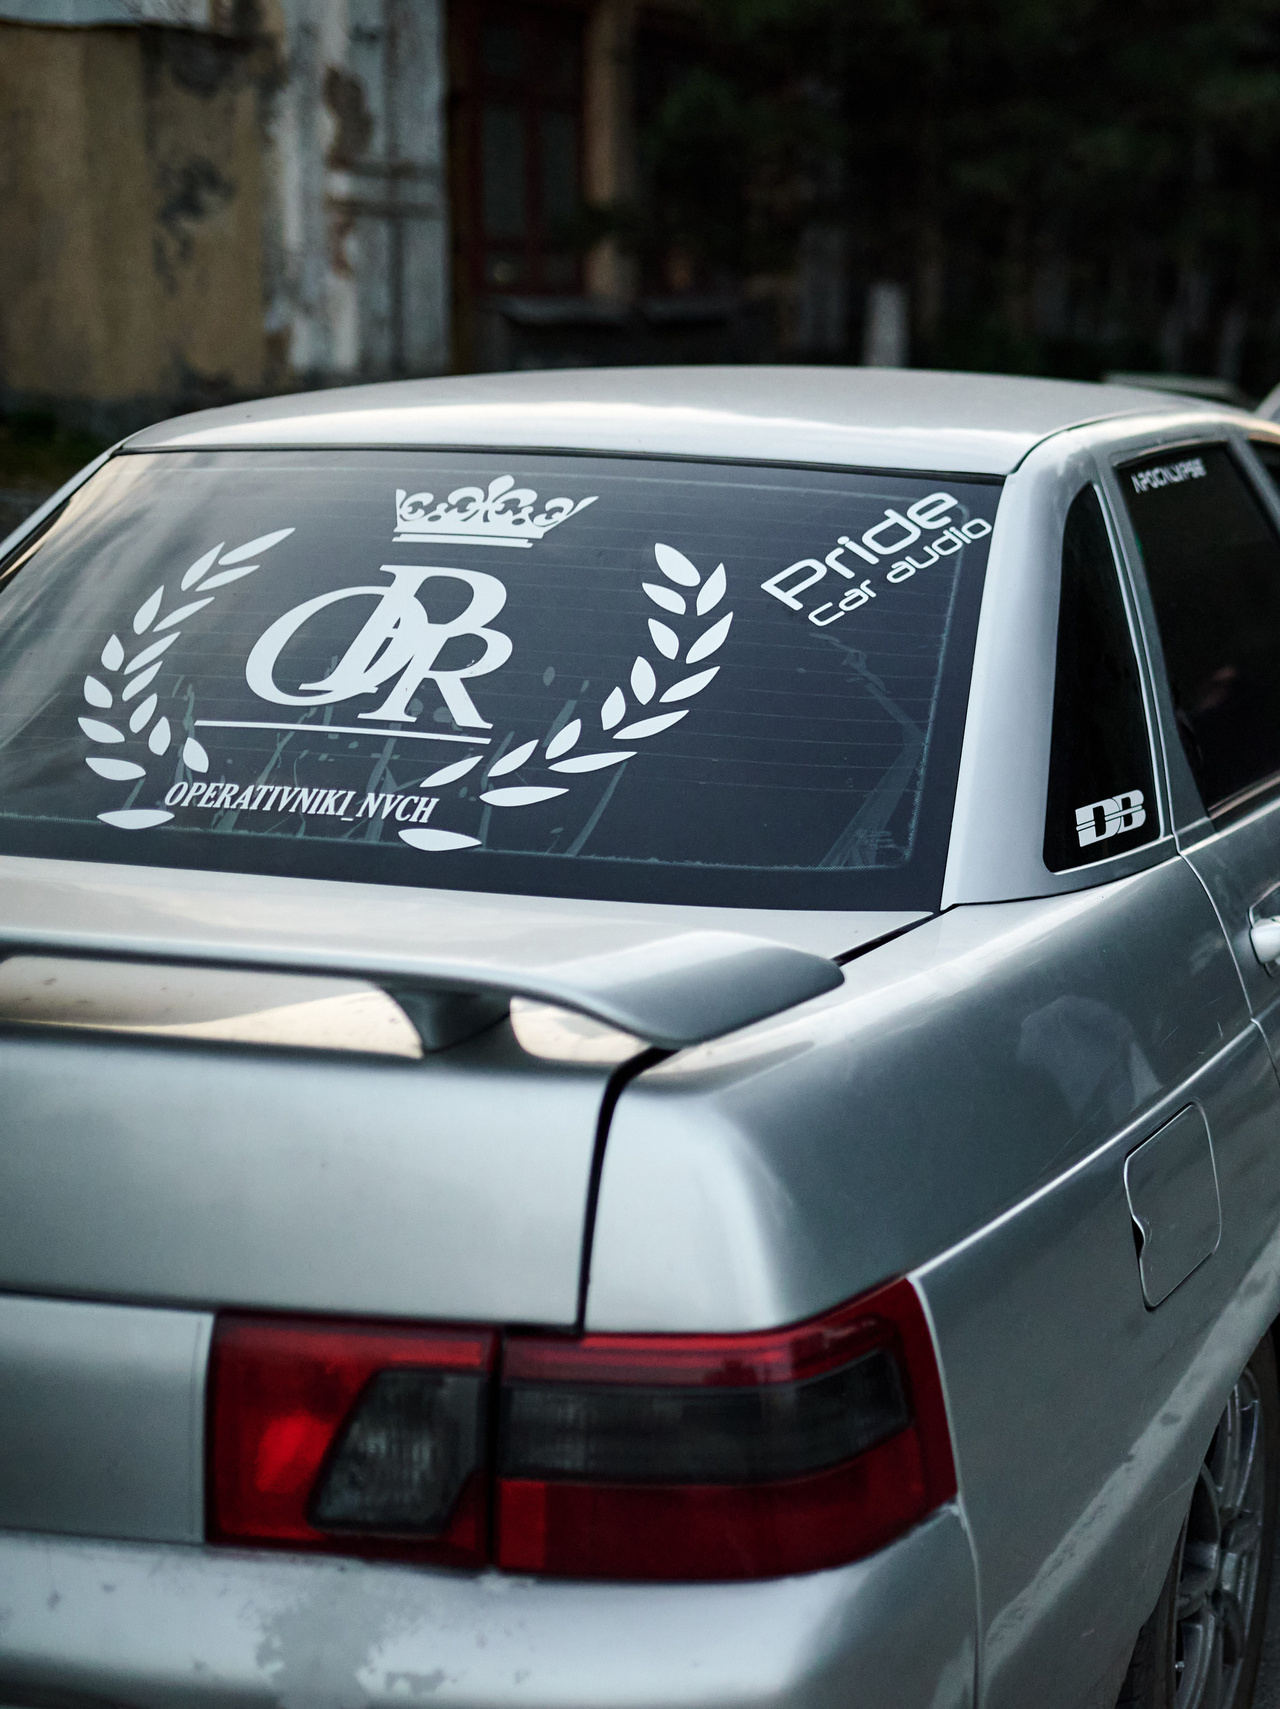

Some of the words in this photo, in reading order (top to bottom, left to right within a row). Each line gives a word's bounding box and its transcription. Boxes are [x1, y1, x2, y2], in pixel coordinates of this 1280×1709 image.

[760, 491, 959, 611] Pride
[808, 579, 877, 627] car
[886, 517, 993, 584] audio
